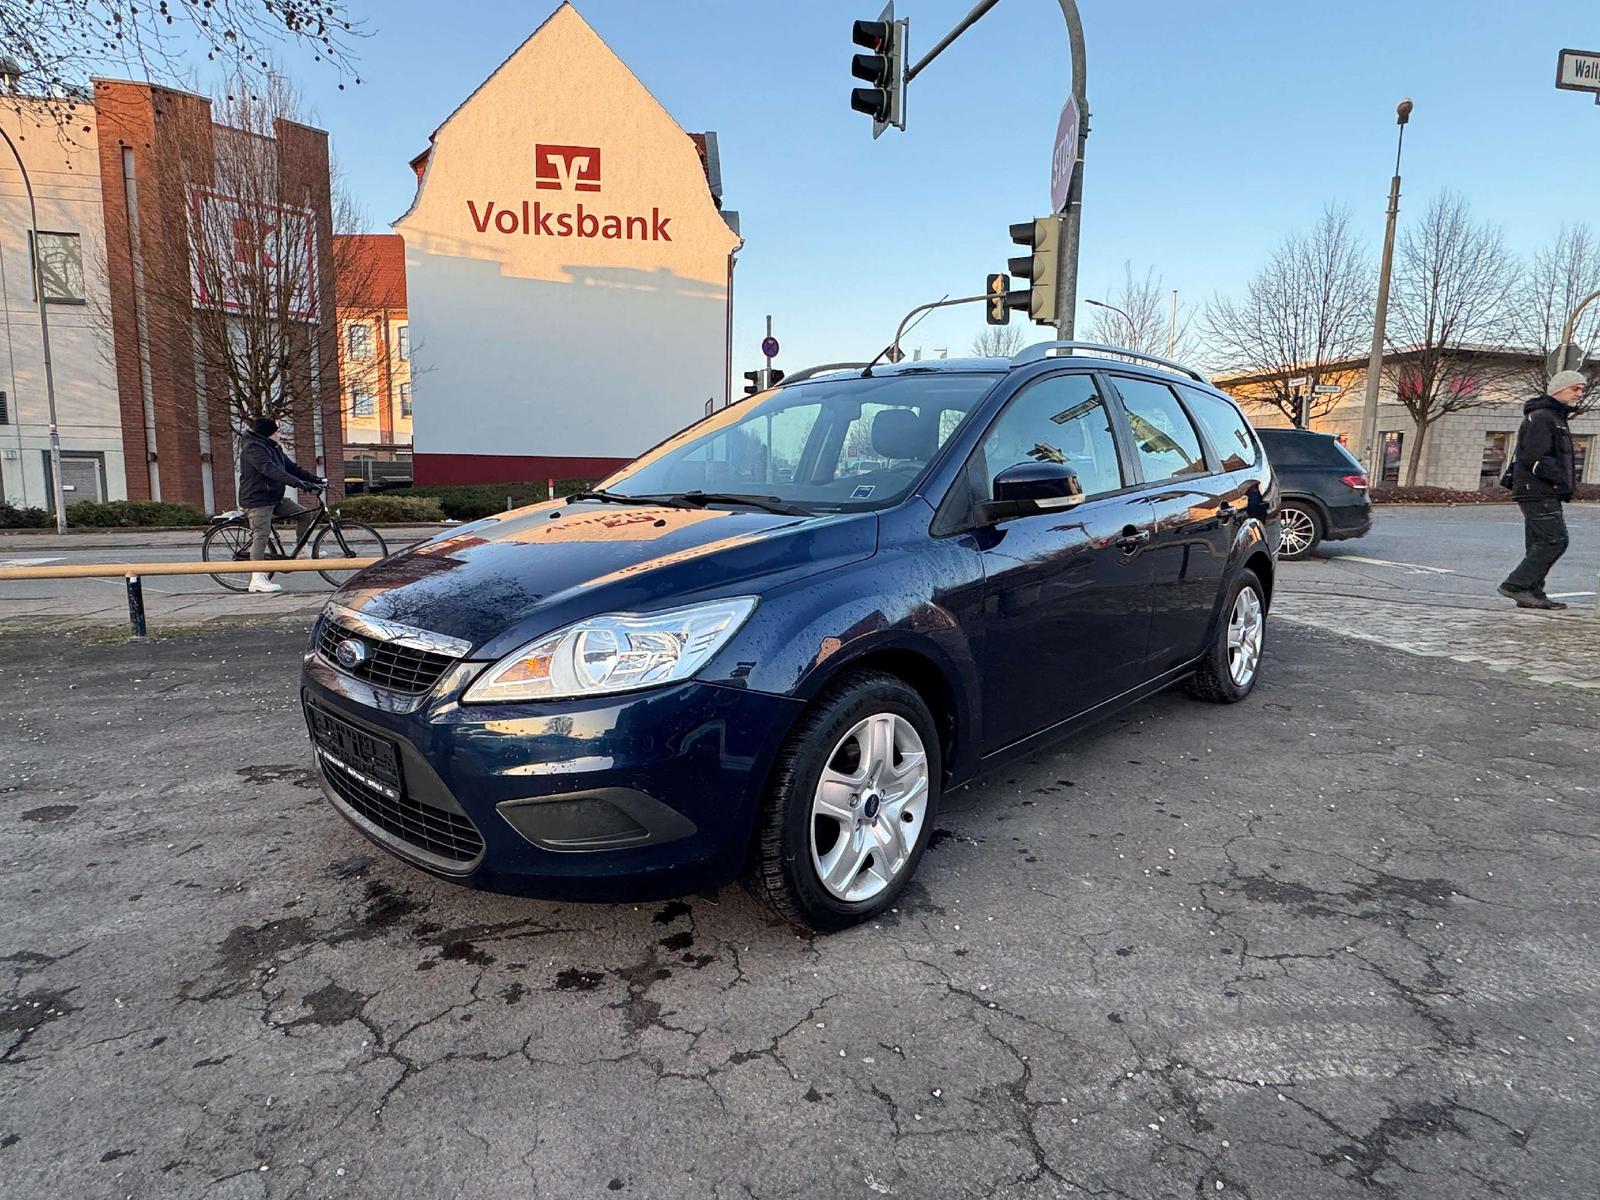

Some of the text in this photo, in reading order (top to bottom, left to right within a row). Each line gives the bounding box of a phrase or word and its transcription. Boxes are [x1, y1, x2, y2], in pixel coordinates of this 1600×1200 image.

[1575, 59, 1600, 83] Walt
[1053, 124, 1075, 188] STOP
[466, 200, 672, 242] Volksbank
